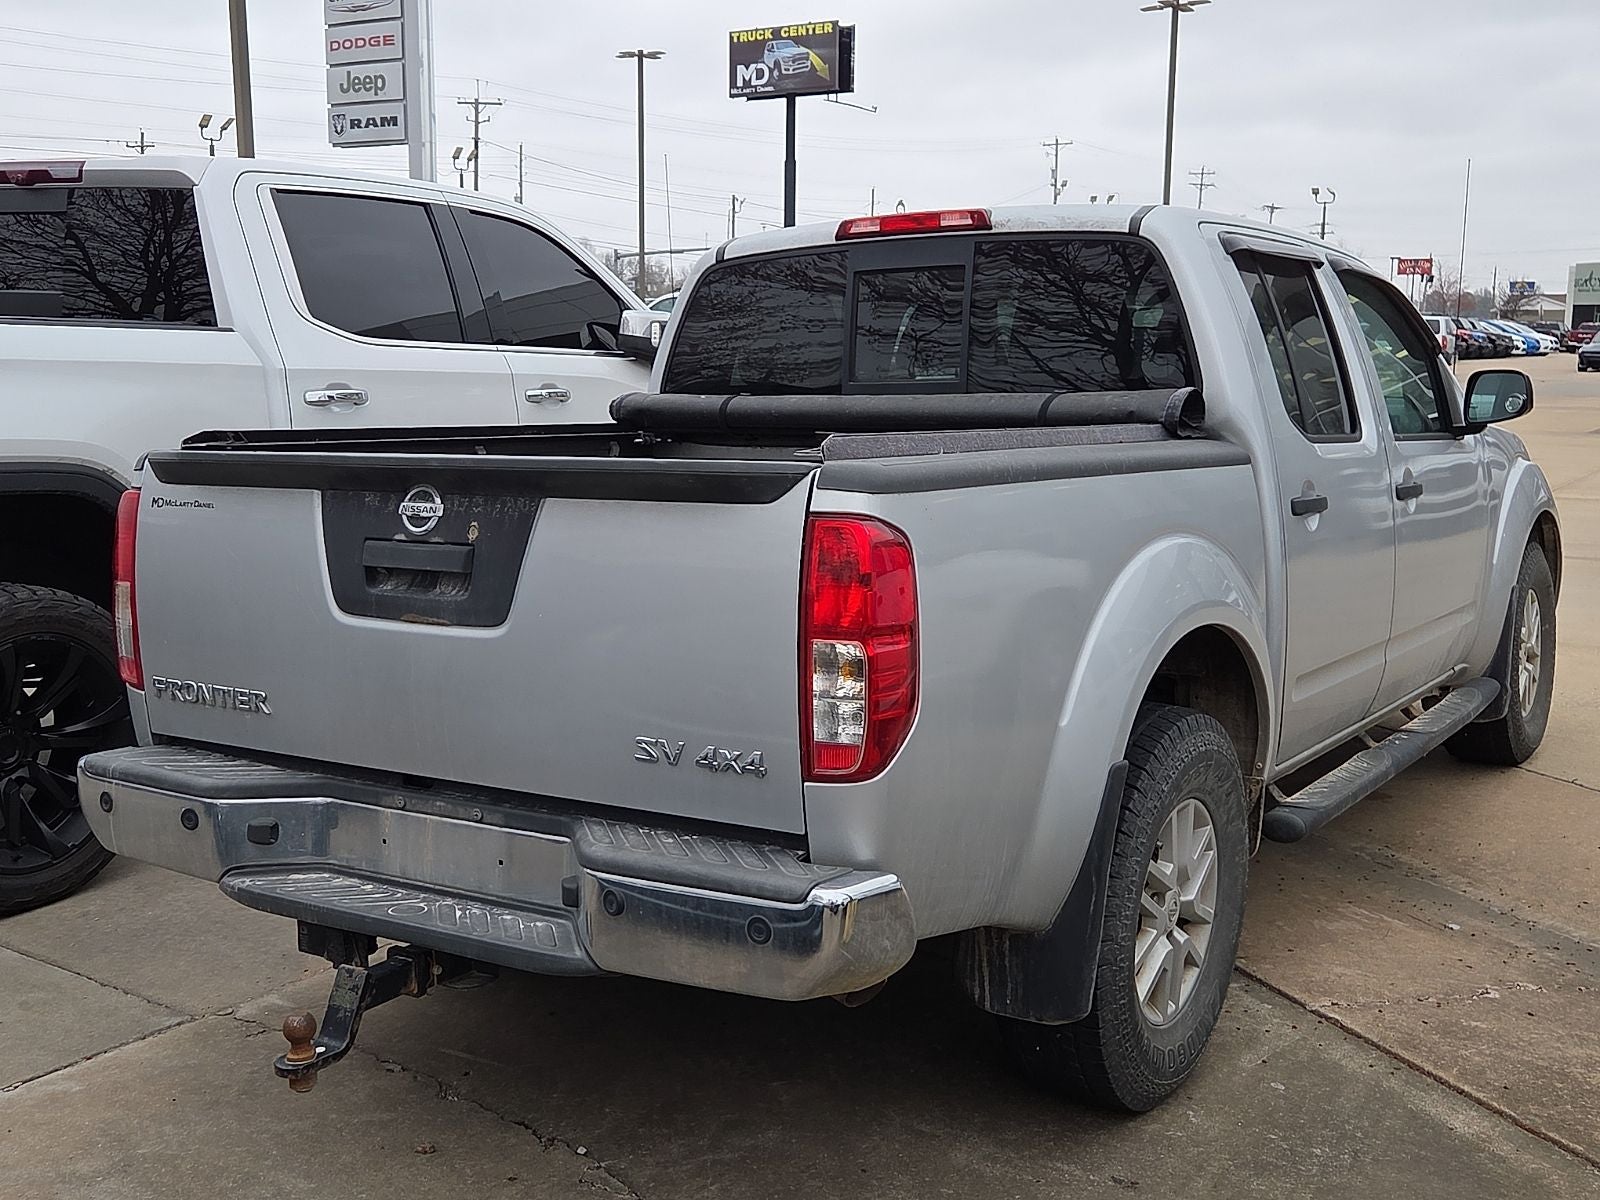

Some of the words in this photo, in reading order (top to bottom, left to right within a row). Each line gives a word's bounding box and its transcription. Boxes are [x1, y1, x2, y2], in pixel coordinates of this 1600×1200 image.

[329, 34, 396, 52] DODGE
[731, 29, 774, 43] TRUCK
[780, 22, 833, 38] CENTER
[339, 70, 387, 96] Jeep
[736, 63, 770, 87] MD
[349, 115, 399, 130] RAM
[400, 503, 438, 515] NISSAN
[152, 675, 272, 715] FRONTIER
[633, 735, 685, 766] SV
